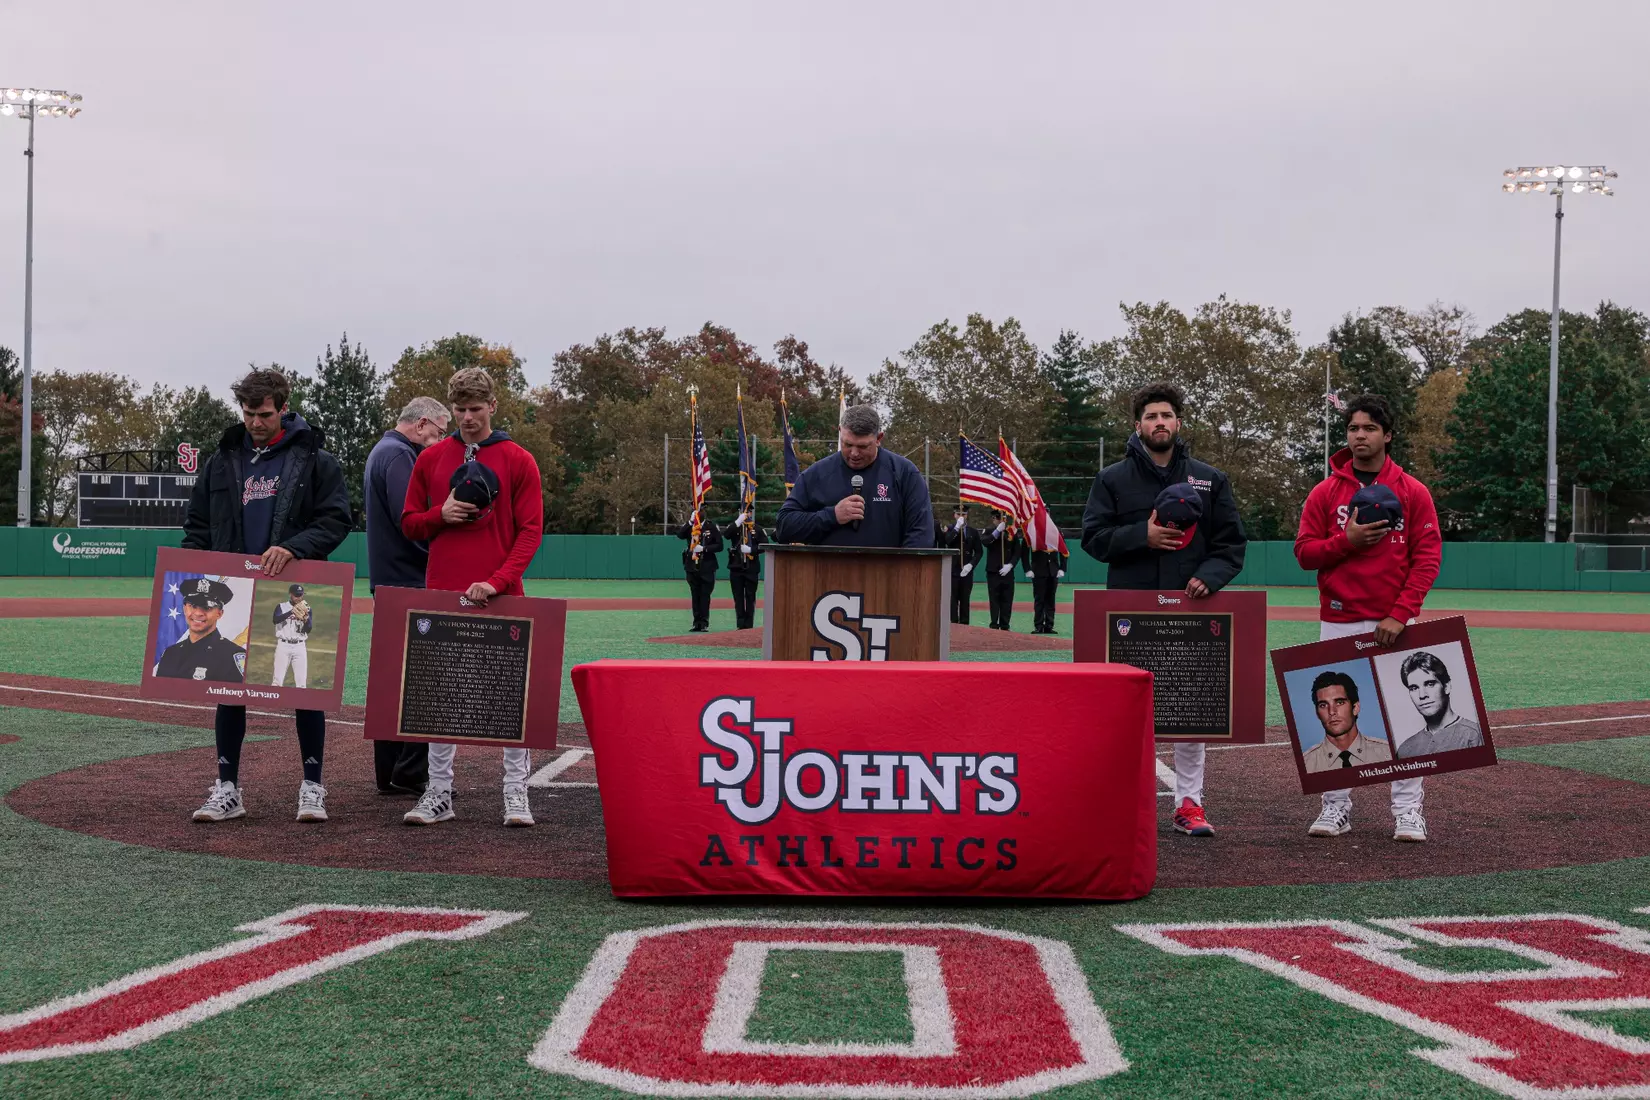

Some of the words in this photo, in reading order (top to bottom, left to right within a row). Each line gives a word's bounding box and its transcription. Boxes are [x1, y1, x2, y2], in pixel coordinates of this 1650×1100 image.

[91, 475, 98, 484] AT
[62, 547, 126, 555] PROFESSIONAL
[437, 620, 471, 628] ANTHONY
[206, 686, 245, 697] Anthony
[245, 689, 280, 699] Varvaro
[1359, 764, 1394, 779] Michael
[1393, 759, 1438, 773] Weinburg
[715, 748, 1021, 826] JOHN'S
[699, 834, 1018, 871] ATHLETICS
